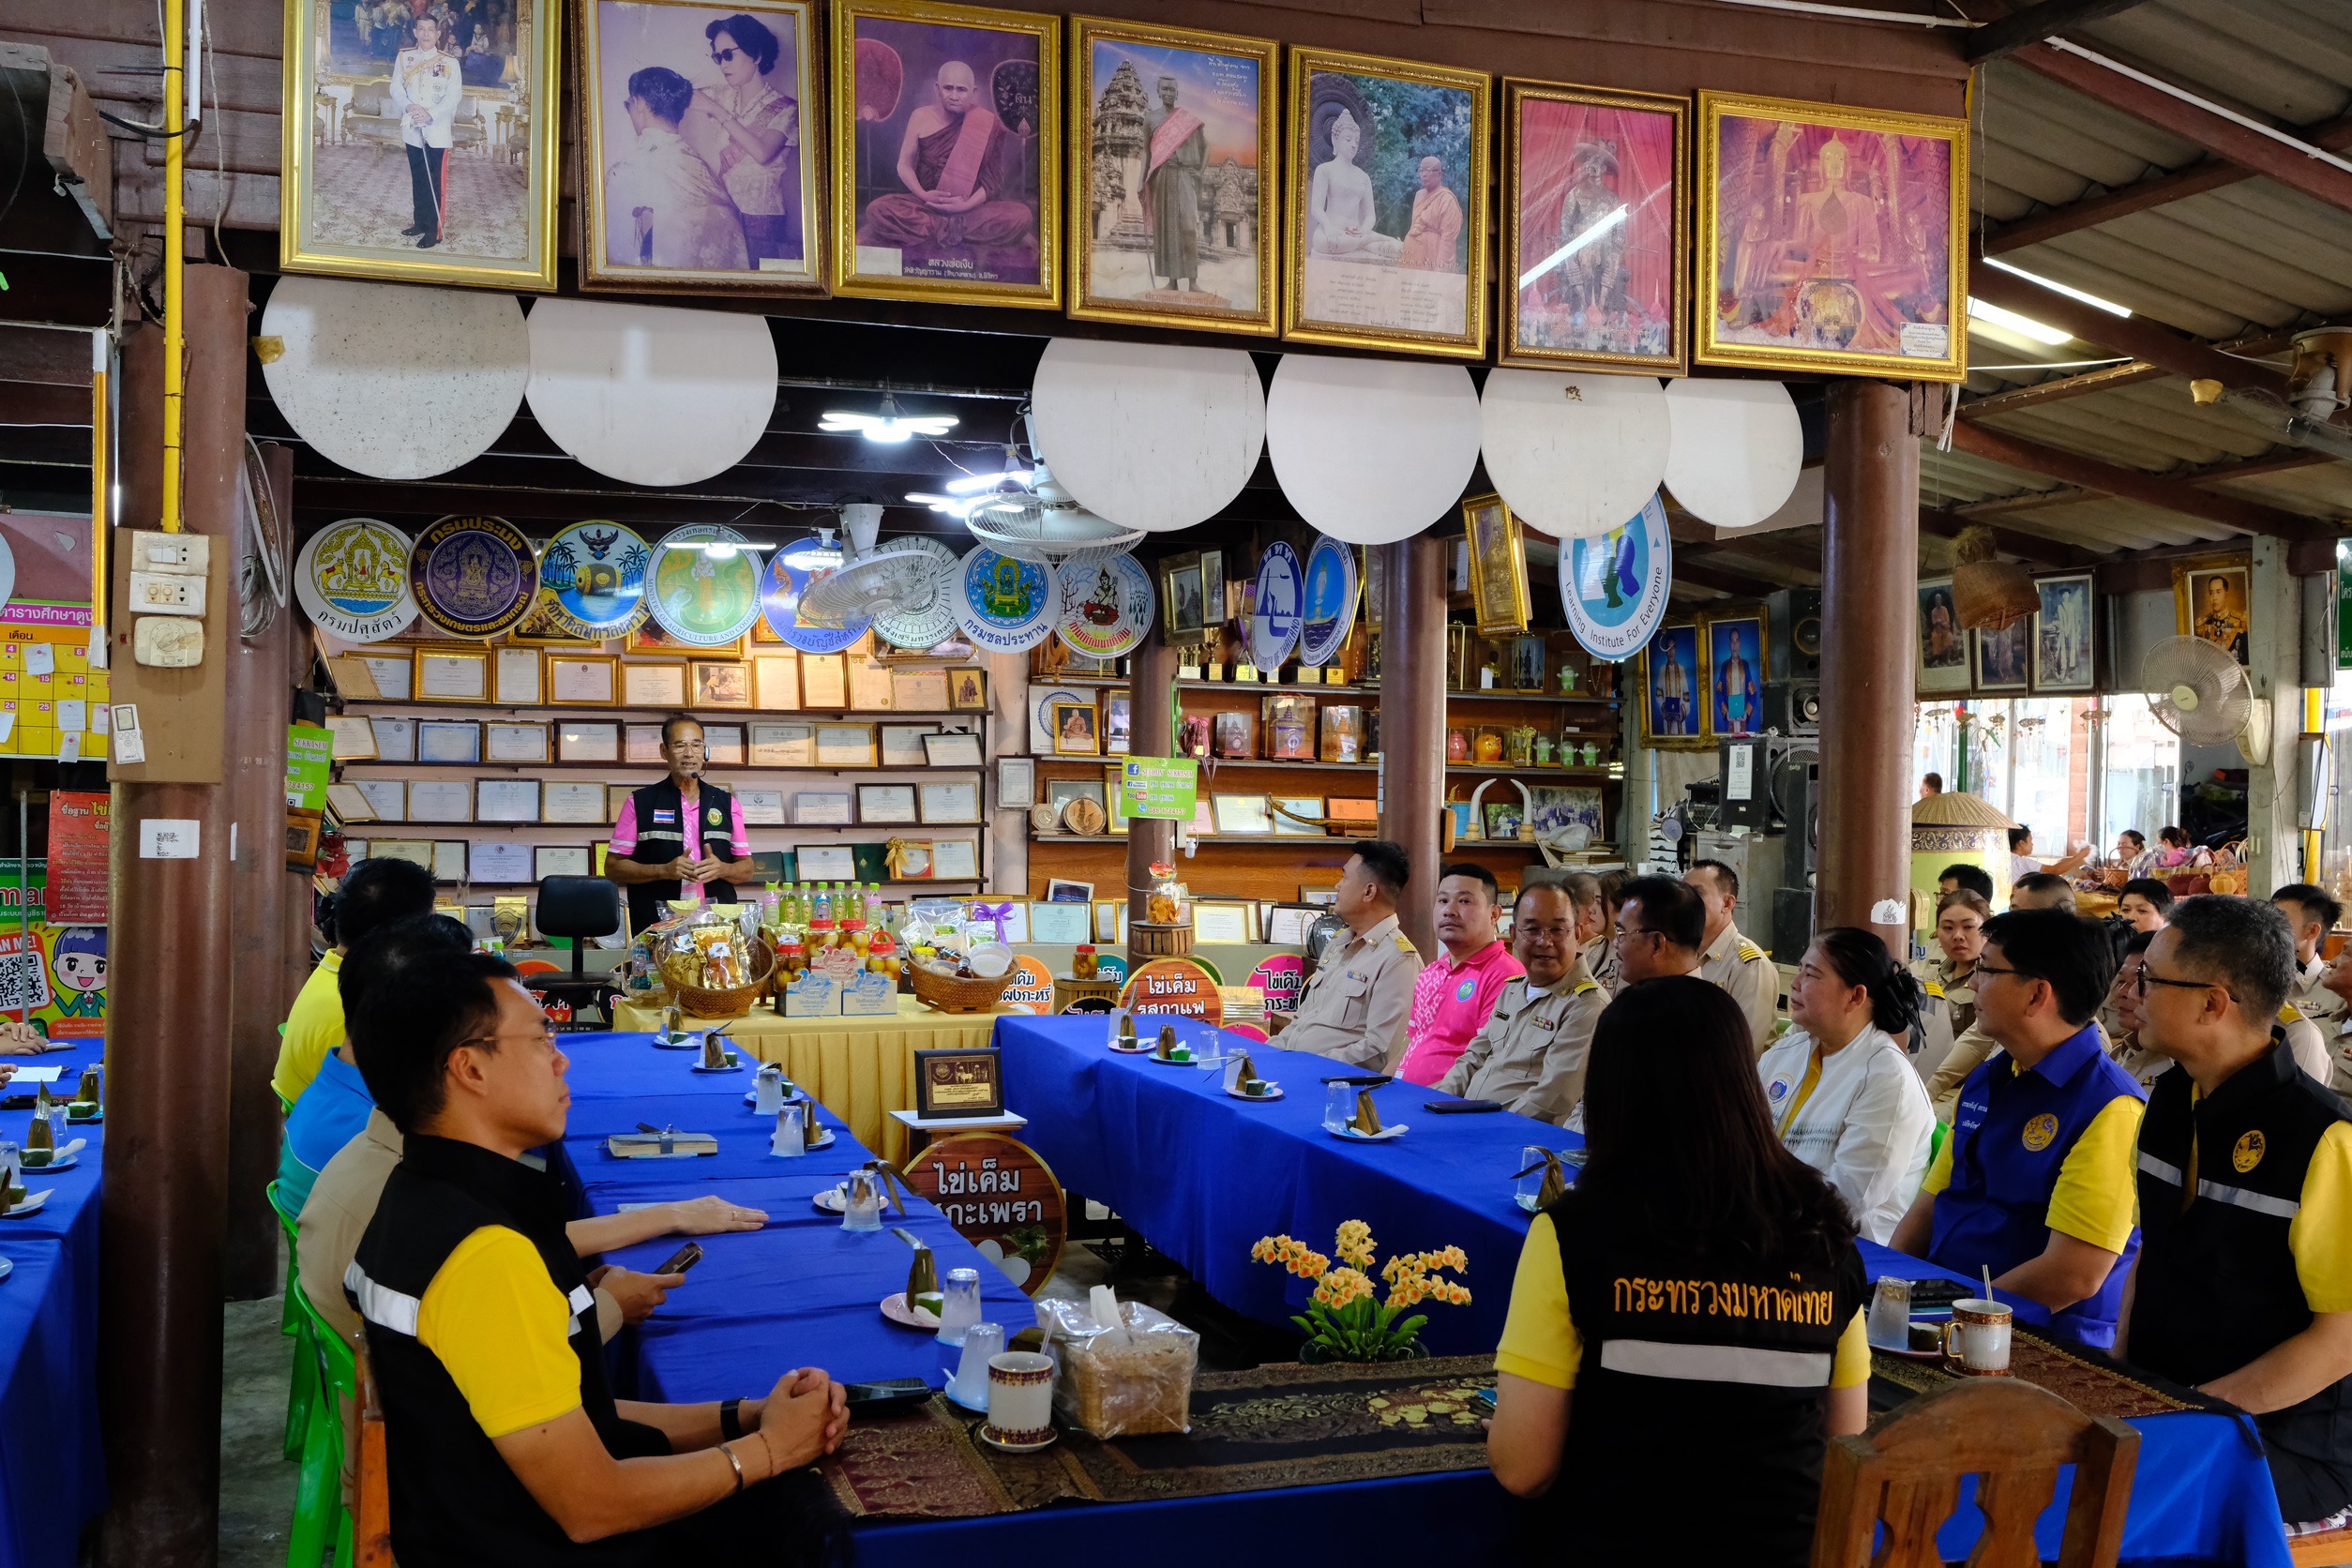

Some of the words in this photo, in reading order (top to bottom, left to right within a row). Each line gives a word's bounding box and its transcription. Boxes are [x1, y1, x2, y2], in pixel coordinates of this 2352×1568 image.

[430, 517, 522, 550] กรมประมง
[415, 581, 529, 632] กระทรวงเกษตรและสหกรณ์
[648, 578, 662, 615] MINISTRY
[659, 612, 669, 625] OF
[668, 622, 717, 642] AGRICULTURE
[719, 630, 735, 641] AND
[1565, 581, 1586, 633] Learning
[1590, 629, 1625, 648] Institute
[1626, 625, 1640, 642] For
[1639, 566, 1663, 626] Everyone
[8, 630, 33, 641] เดือน
[318, 610, 401, 639] กรมปศุสัตว์
[964, 618, 1048, 646] กรมชลประทาน
[1280, 618, 1300, 658] THAILAND
[1331, 620, 1345, 647] SPORTS
[91, 801, 110, 816] ไข่
[1146, 972, 1197, 995] ไข่เค็ม
[1255, 966, 1302, 989] ไข่เค็ม
[999, 984, 1051, 1002] ผงกะหรี่
[1138, 1000, 1205, 1015] รสกาแฟ
[933, 1158, 1019, 1195] ไข่เค็ม
[938, 1199, 1042, 1226] กะเพรา
